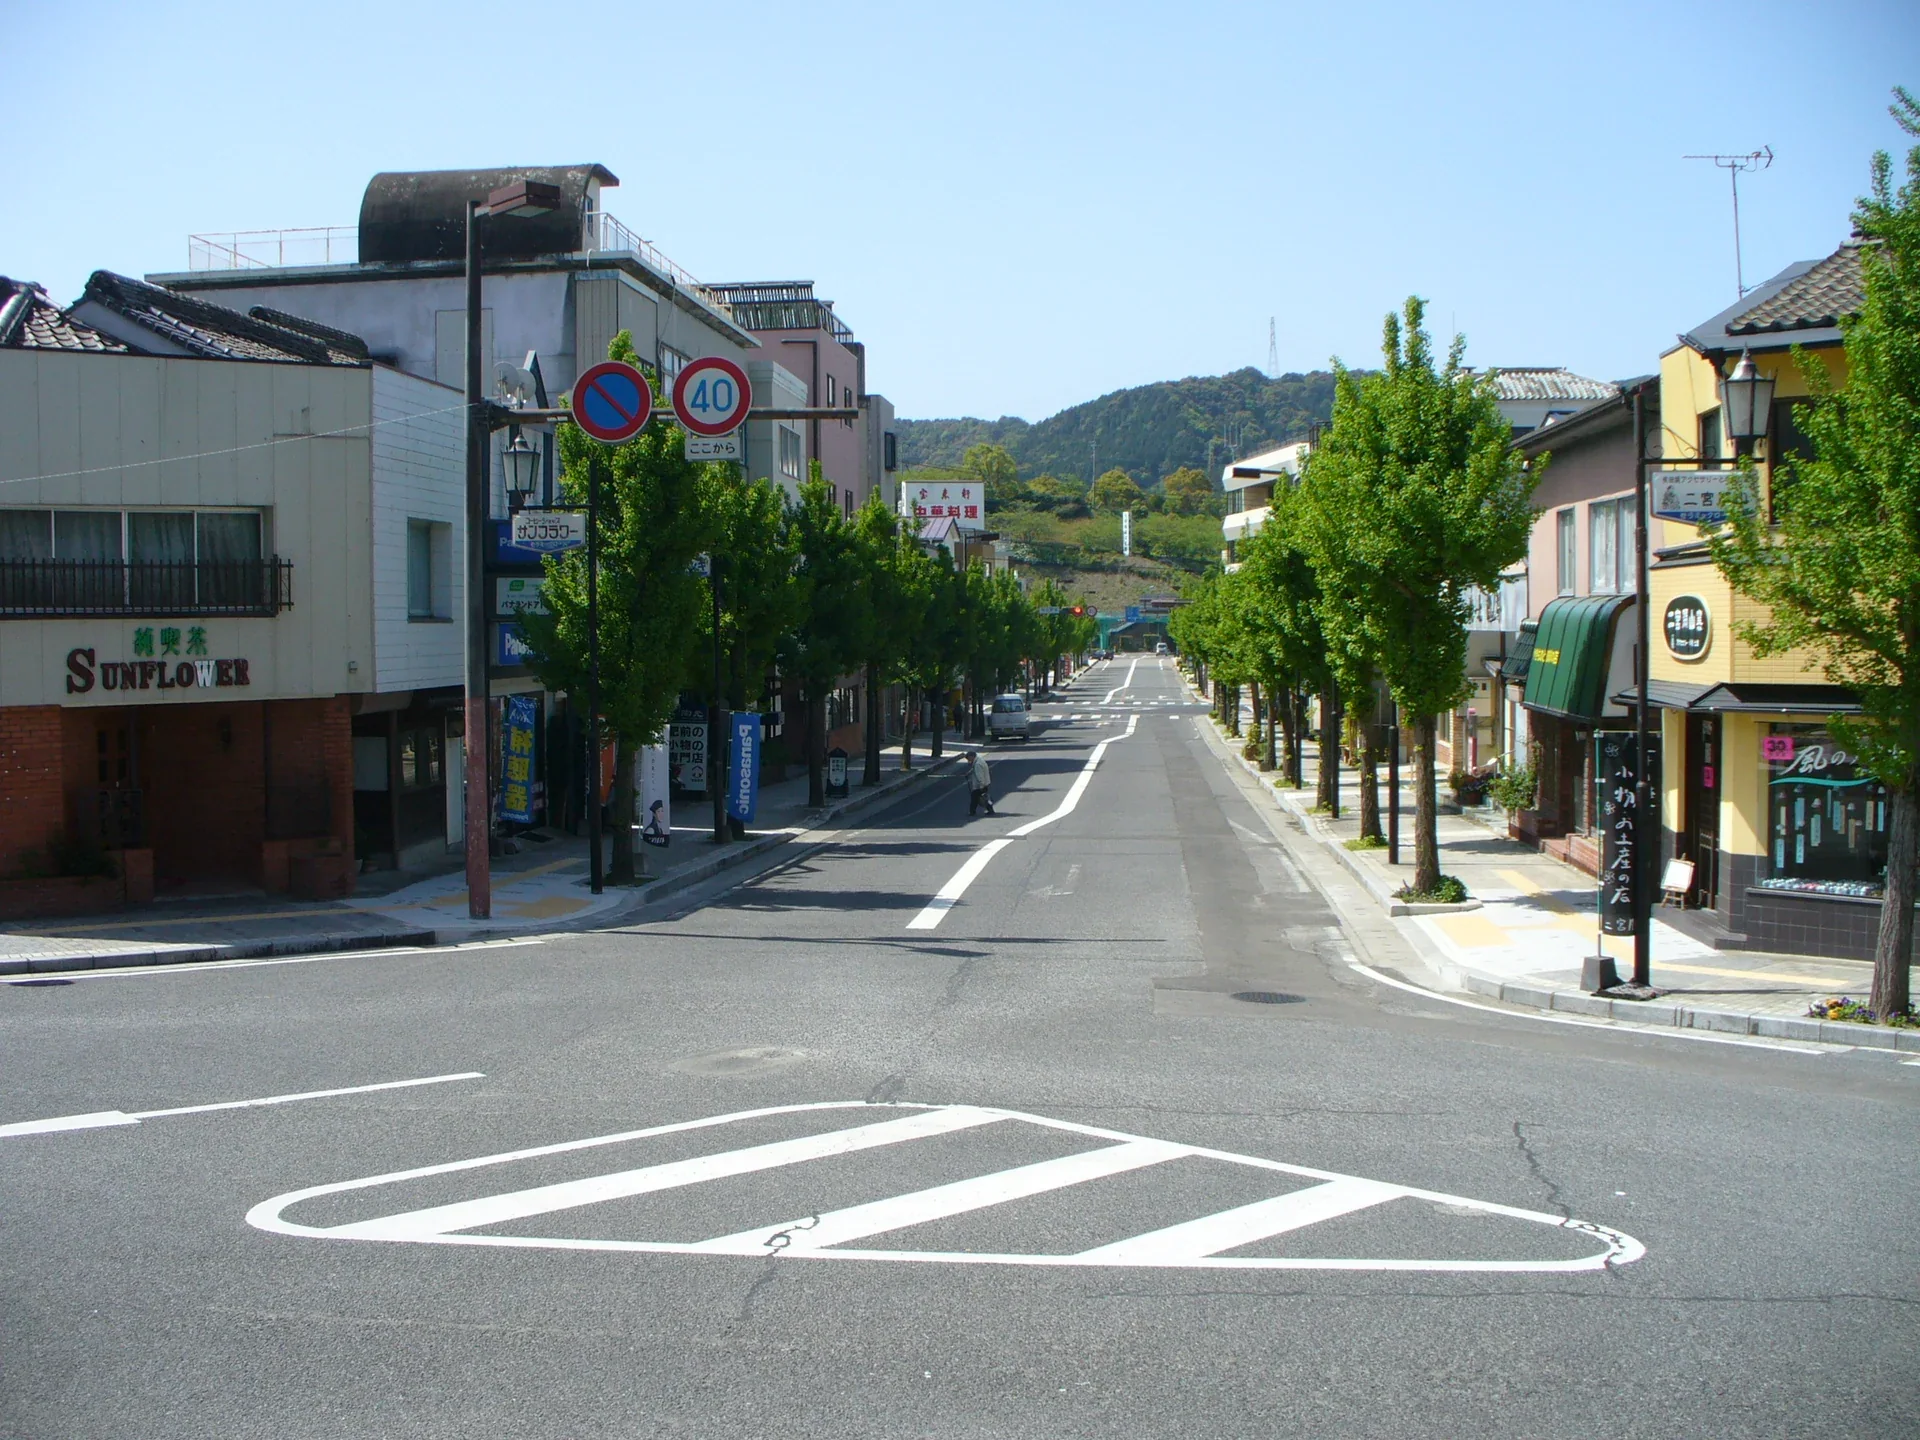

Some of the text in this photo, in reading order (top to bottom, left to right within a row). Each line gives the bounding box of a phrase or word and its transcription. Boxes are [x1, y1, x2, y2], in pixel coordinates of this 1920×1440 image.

[690, 378, 733, 413] 40
[690, 442, 736, 454] ここから
[915, 505, 978, 519] 中華料理
[517, 525, 579, 540] サンフラワー
[66, 648, 251, 694] SUNFLOWER
